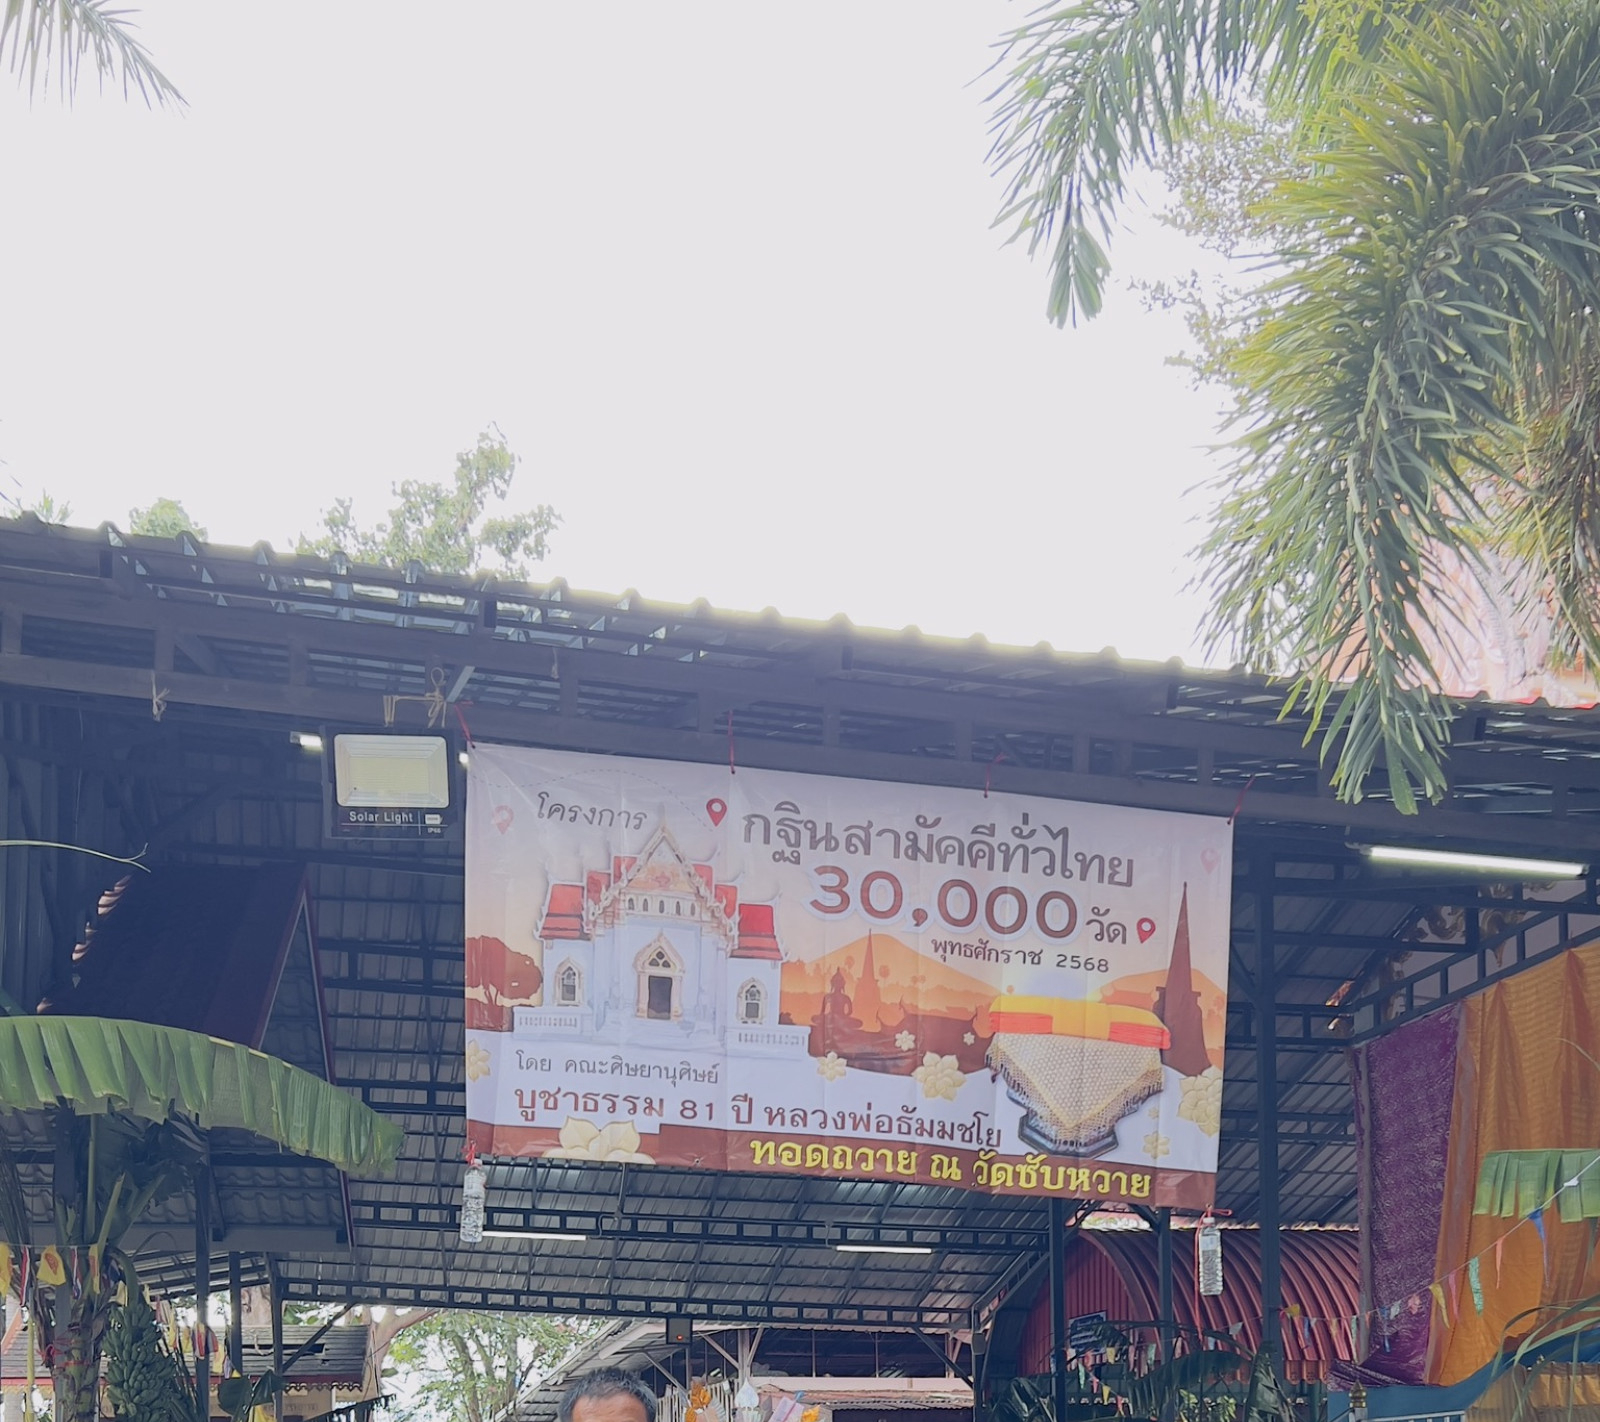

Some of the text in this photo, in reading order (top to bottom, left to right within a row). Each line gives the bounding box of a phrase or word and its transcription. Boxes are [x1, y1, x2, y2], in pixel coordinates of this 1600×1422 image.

[349, 811, 413, 825] Solar Light
[537, 792, 648, 830] โครงการ
[742, 801, 1134, 888] กฐินสามัคคีทั่วไทย
[809, 865, 1128, 944] 30,000 วัด
[931, 936, 1110, 973] พุทธศักราช 2568
[516, 1050, 720, 1087] โดย คณะศิษยานุศิษย์
[515, 1086, 1001, 1148] บูชาธรรม 81 ปี หลวงพ่อธัมมชโย
[750, 1137, 918, 1175] ทอดถวาย
[930, 1153, 962, 1181] ณ
